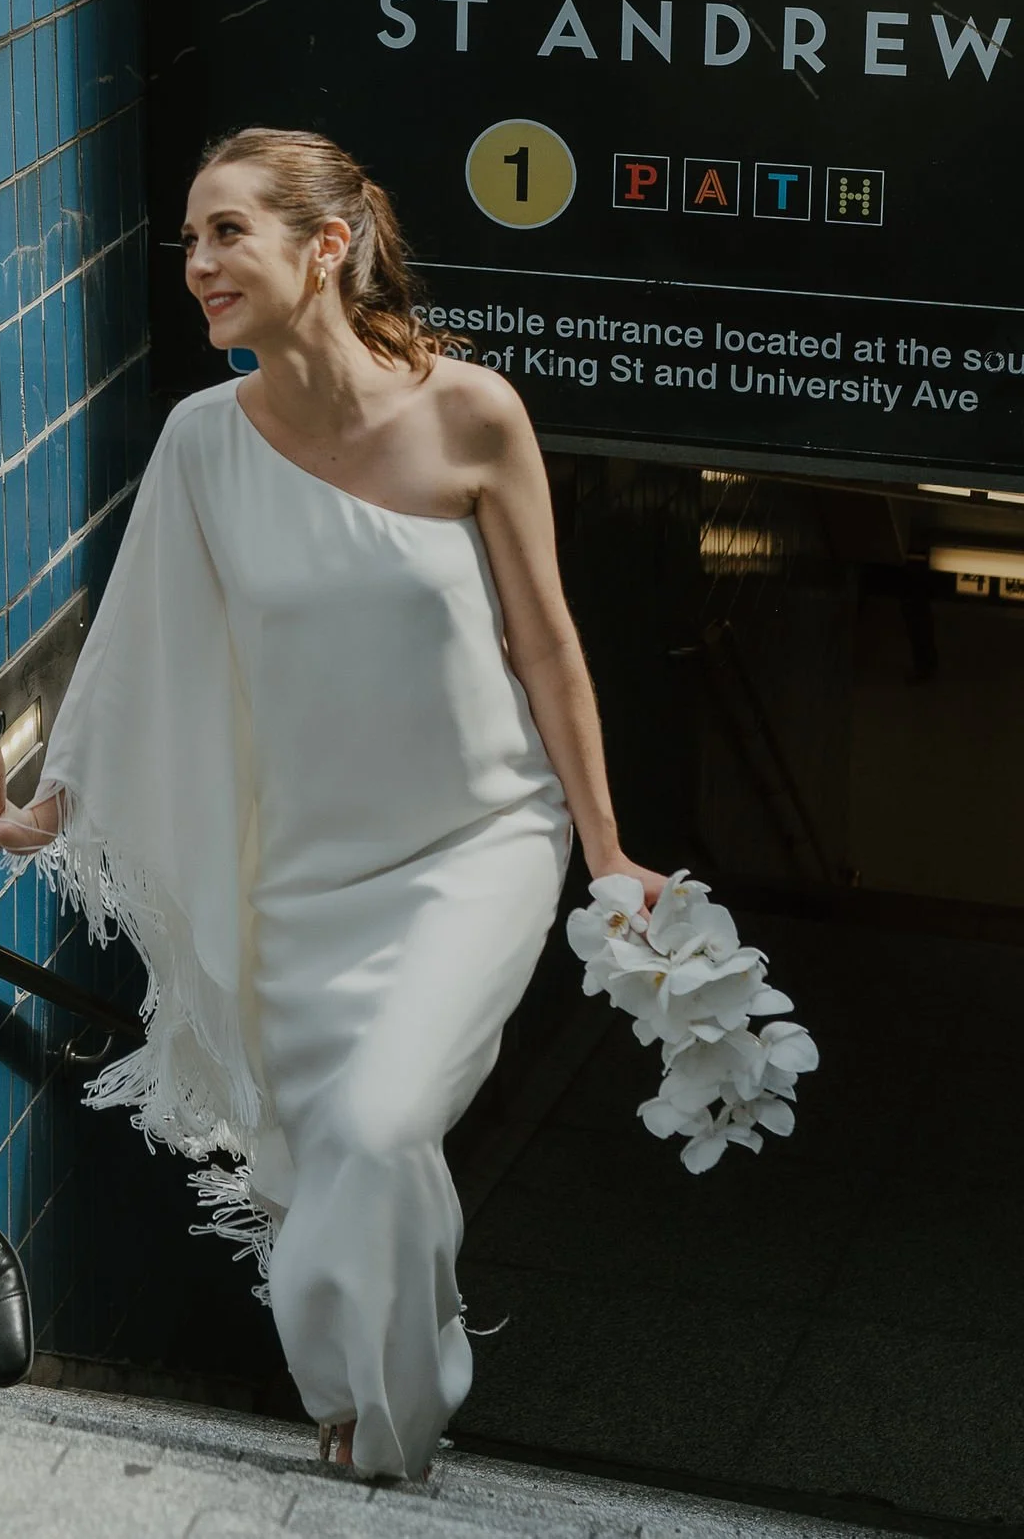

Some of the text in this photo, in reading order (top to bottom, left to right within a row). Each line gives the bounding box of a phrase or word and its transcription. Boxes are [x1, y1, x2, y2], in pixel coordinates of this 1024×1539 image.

[503, 146, 529, 202] 1
[410, 304, 1024, 375] cessible entrance located at the sou
[481, 345, 515, 372] of
[525, 347, 598, 386] King
[610, 354, 645, 384] St
[654, 363, 717, 390] and
[730, 364, 902, 412] University
[912, 380, 980, 412] Ave
